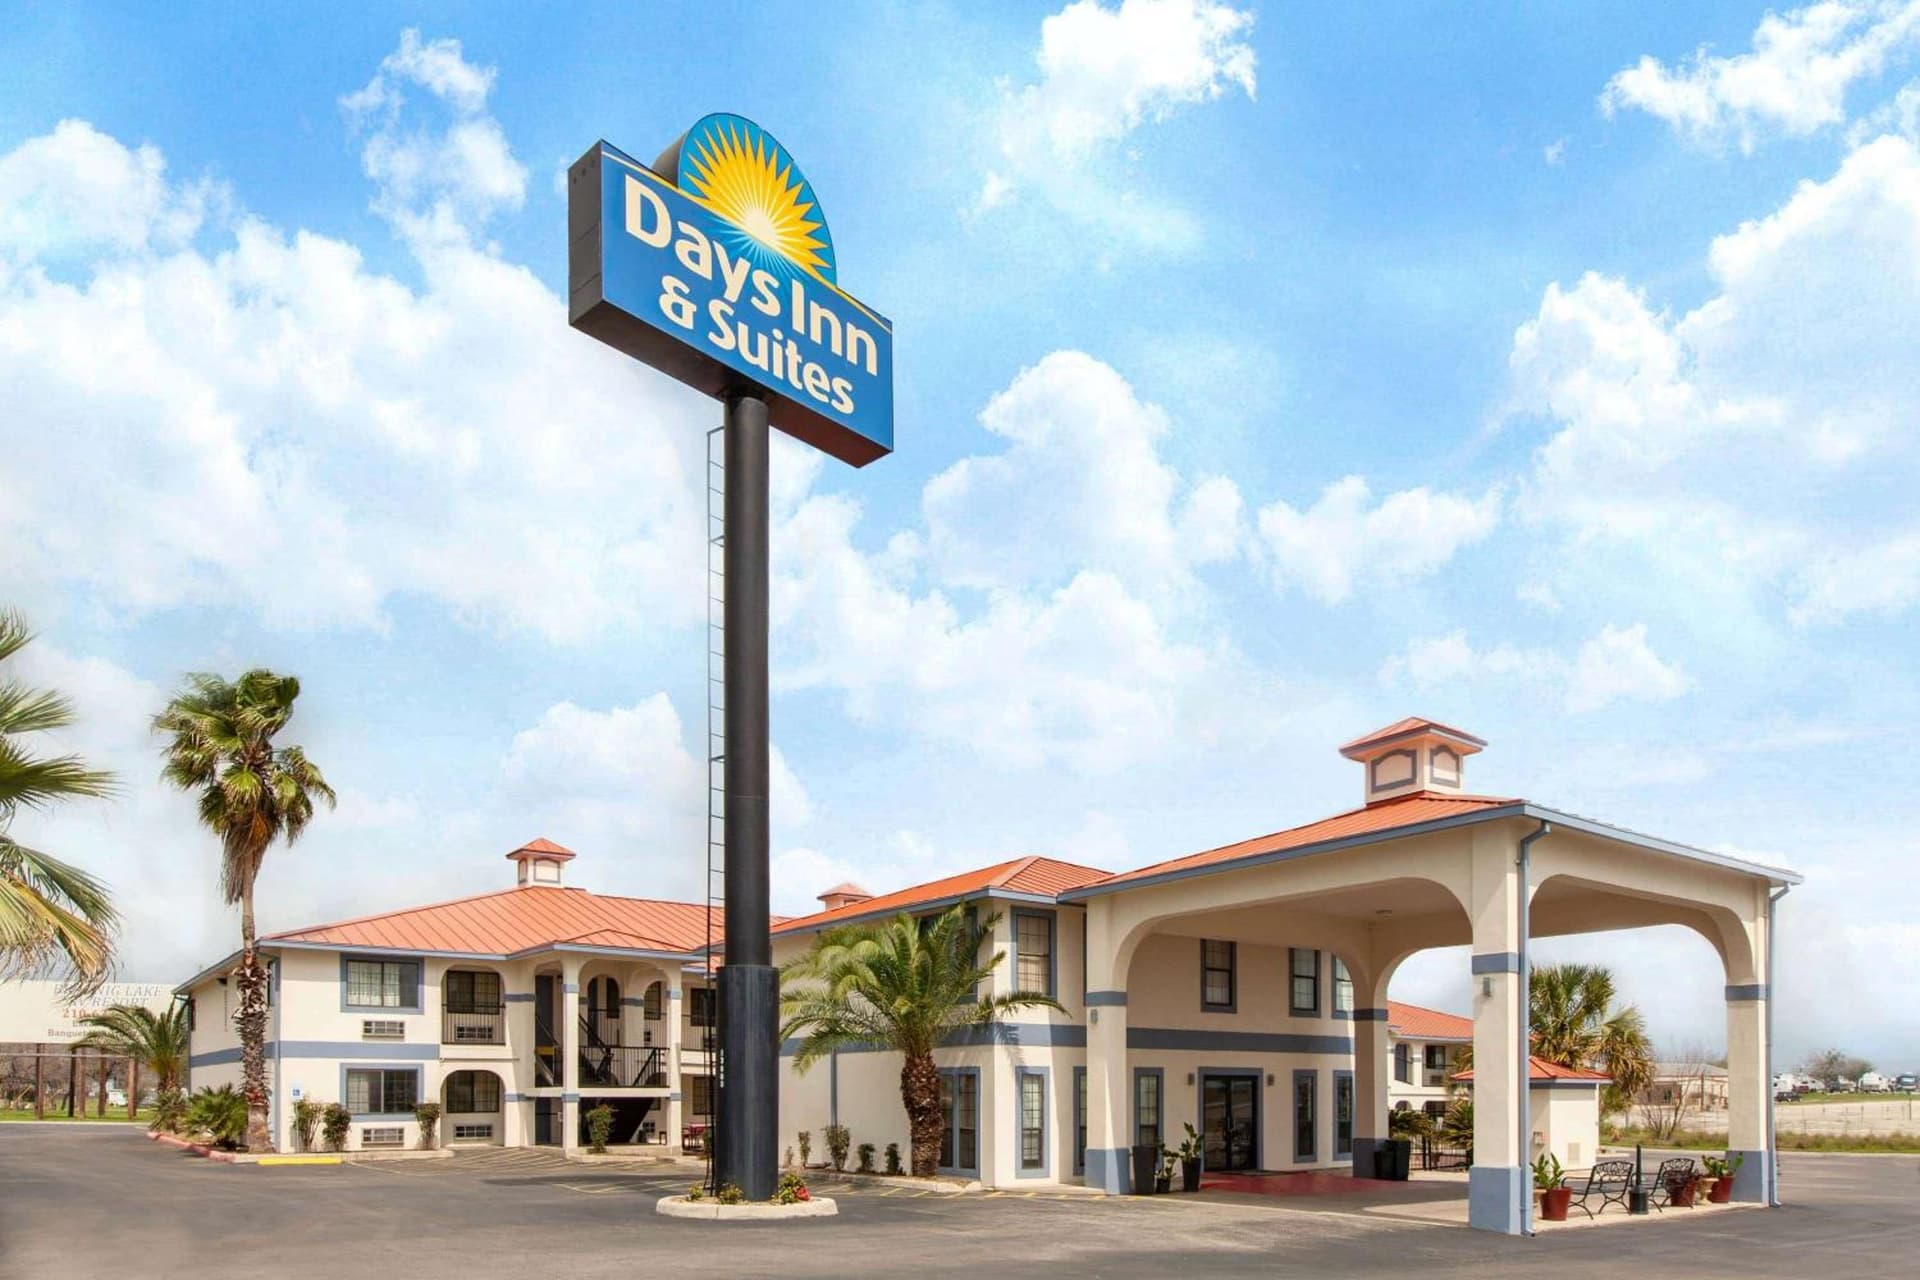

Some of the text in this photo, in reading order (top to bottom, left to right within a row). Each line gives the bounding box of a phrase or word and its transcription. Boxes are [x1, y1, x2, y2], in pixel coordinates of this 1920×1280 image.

[625, 173, 878, 377] Days Inn
[659, 275, 855, 414] & Suites
